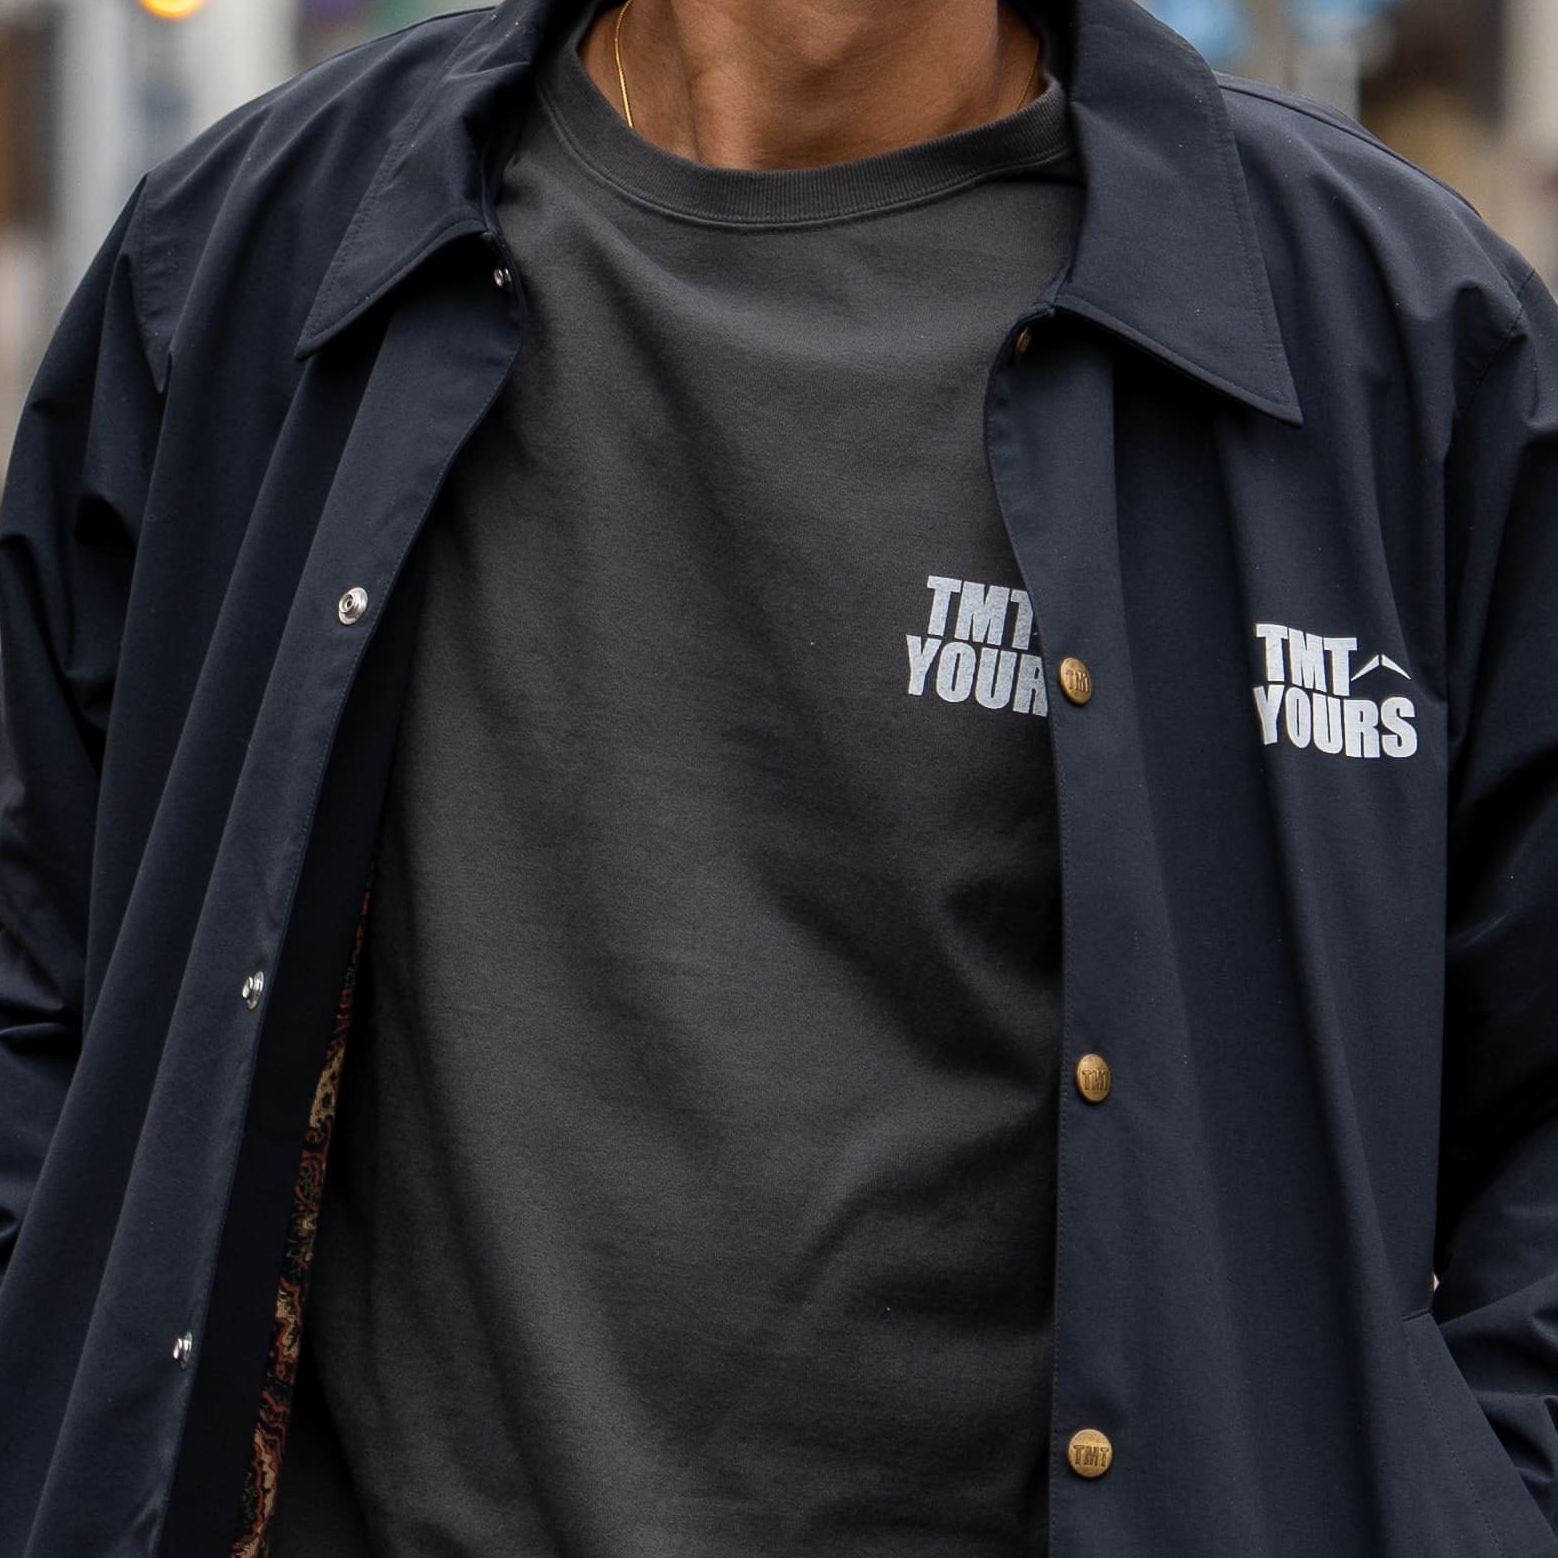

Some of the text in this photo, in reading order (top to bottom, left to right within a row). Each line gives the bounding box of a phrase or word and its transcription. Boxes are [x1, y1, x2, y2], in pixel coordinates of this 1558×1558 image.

[1255, 623, 1358, 696] TMT
[1252, 684, 1418, 758] YOURS
[1073, 1444, 1109, 1468] TMT
